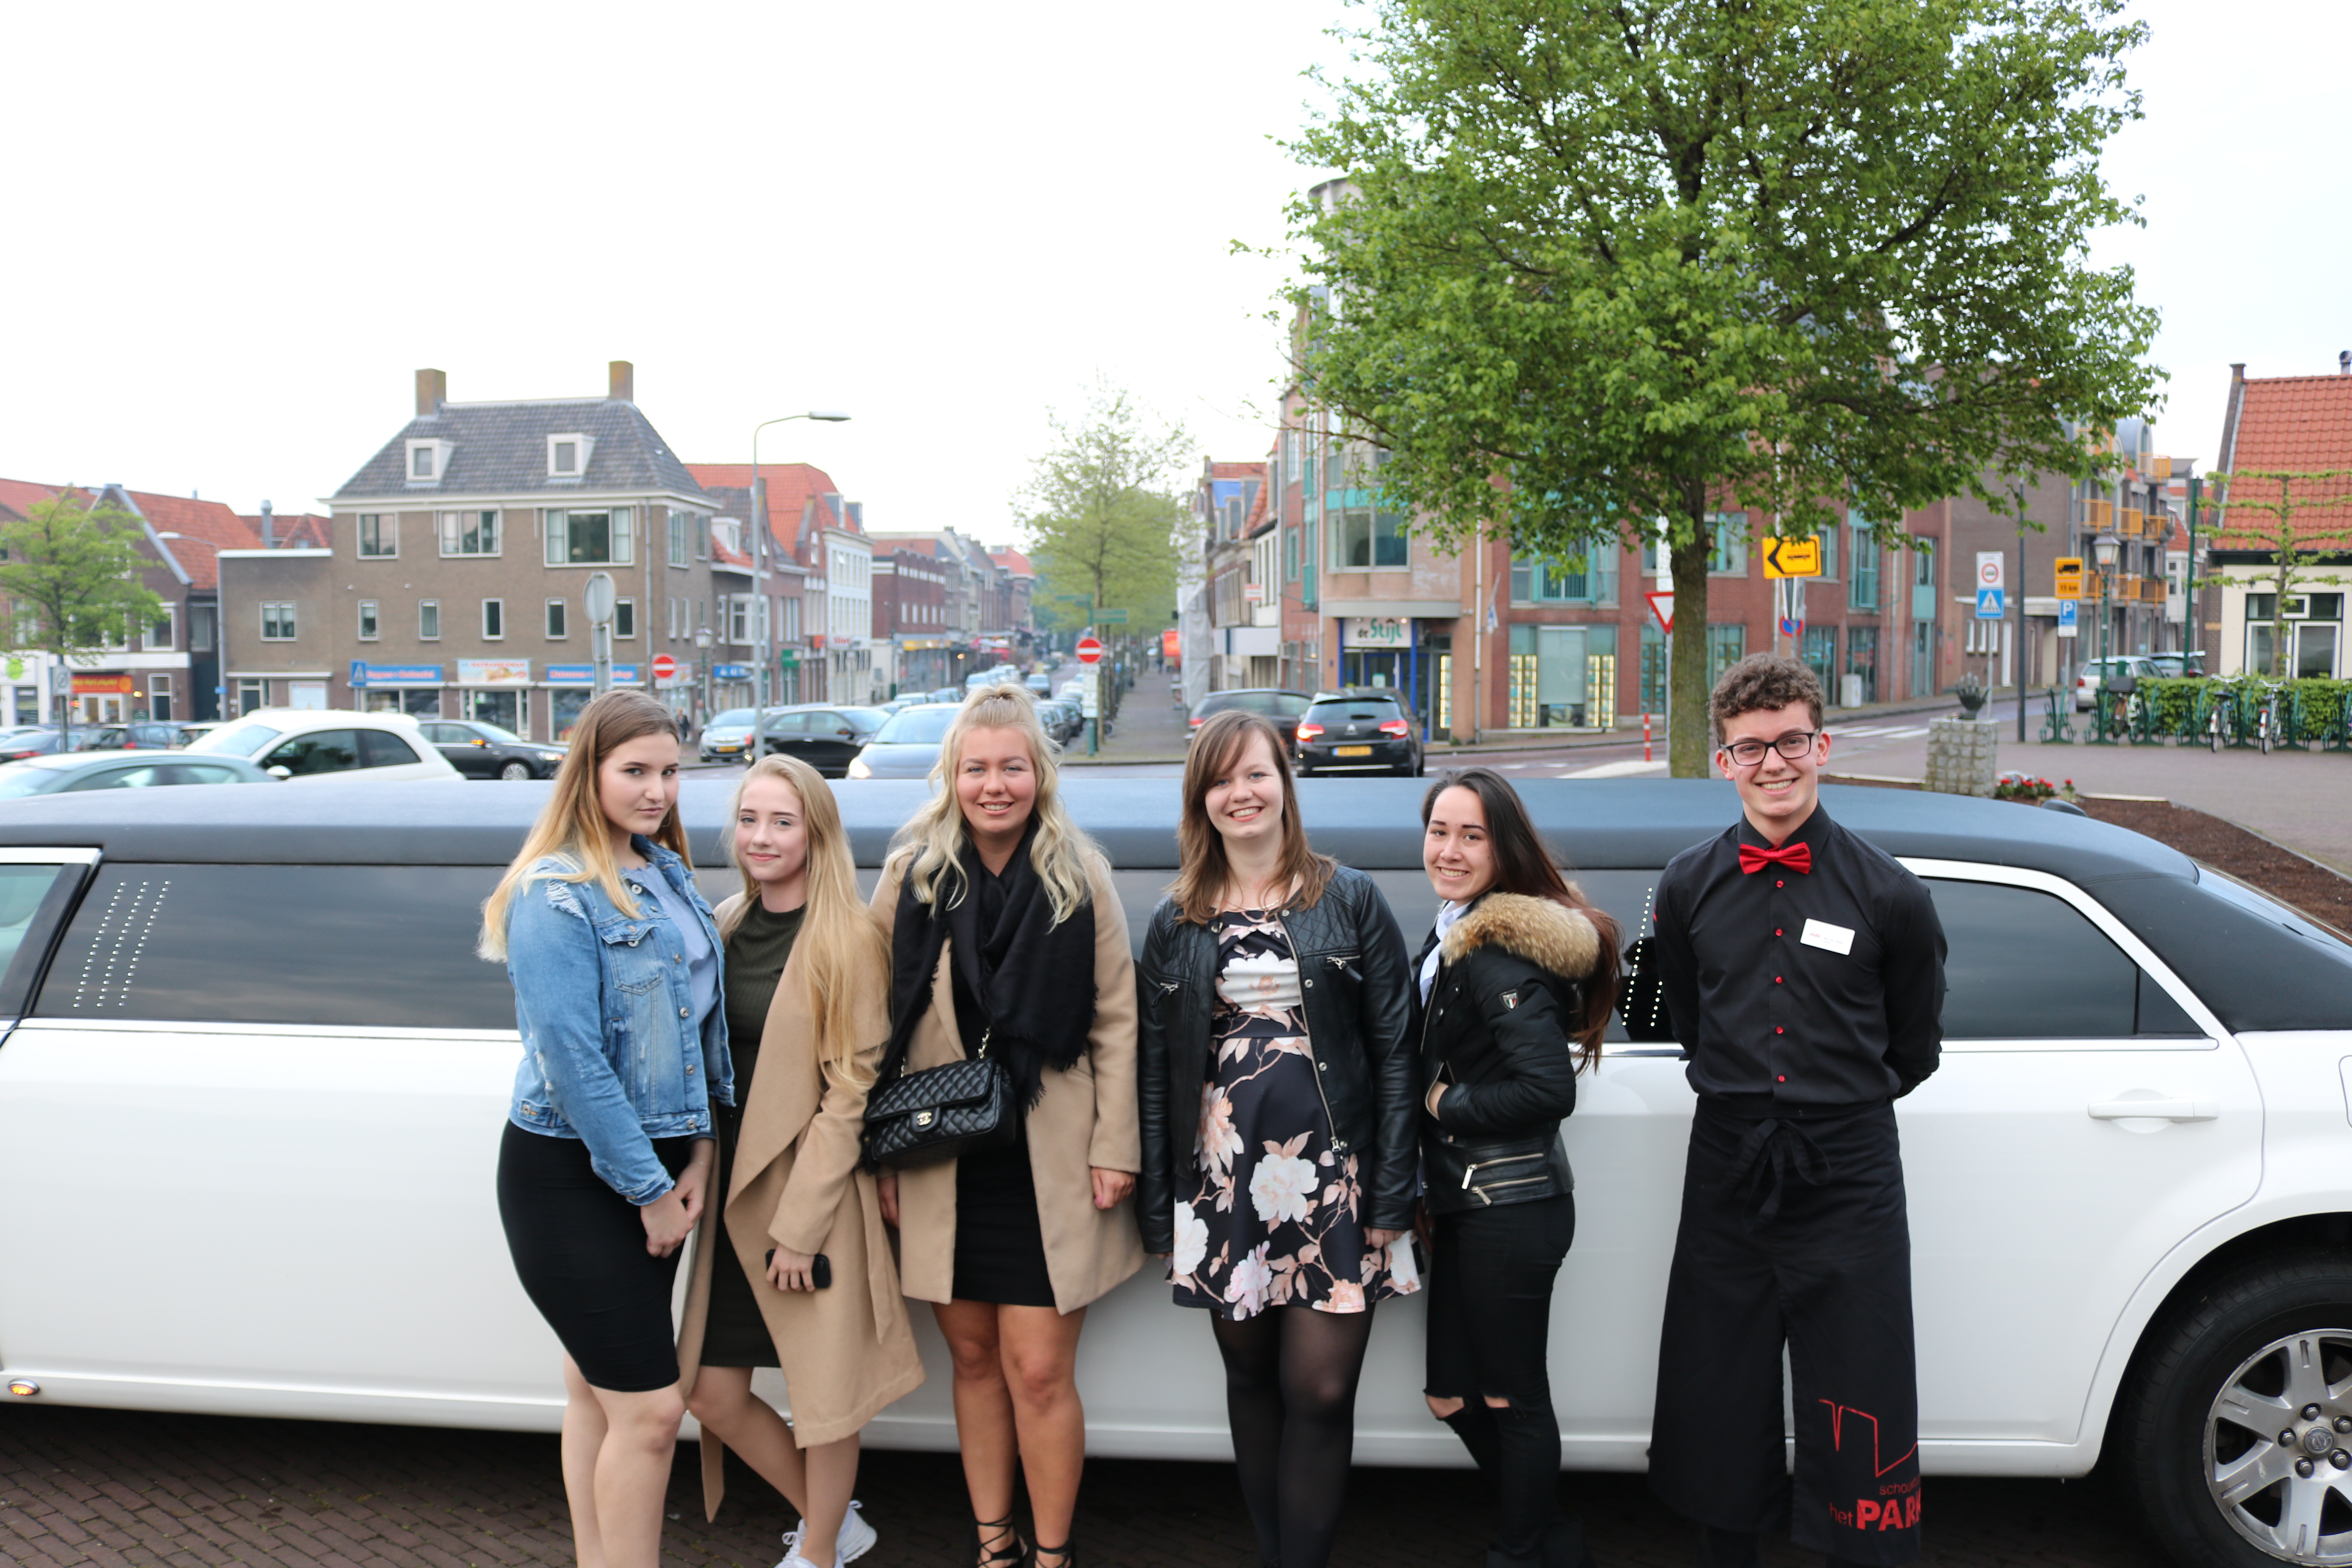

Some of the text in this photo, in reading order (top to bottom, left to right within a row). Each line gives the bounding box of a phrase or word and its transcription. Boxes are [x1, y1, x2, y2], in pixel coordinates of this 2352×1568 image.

[2063, 601, 2074, 617] P
[1357, 618, 1402, 644] de Stijl
[1829, 1501, 1853, 1527] het
